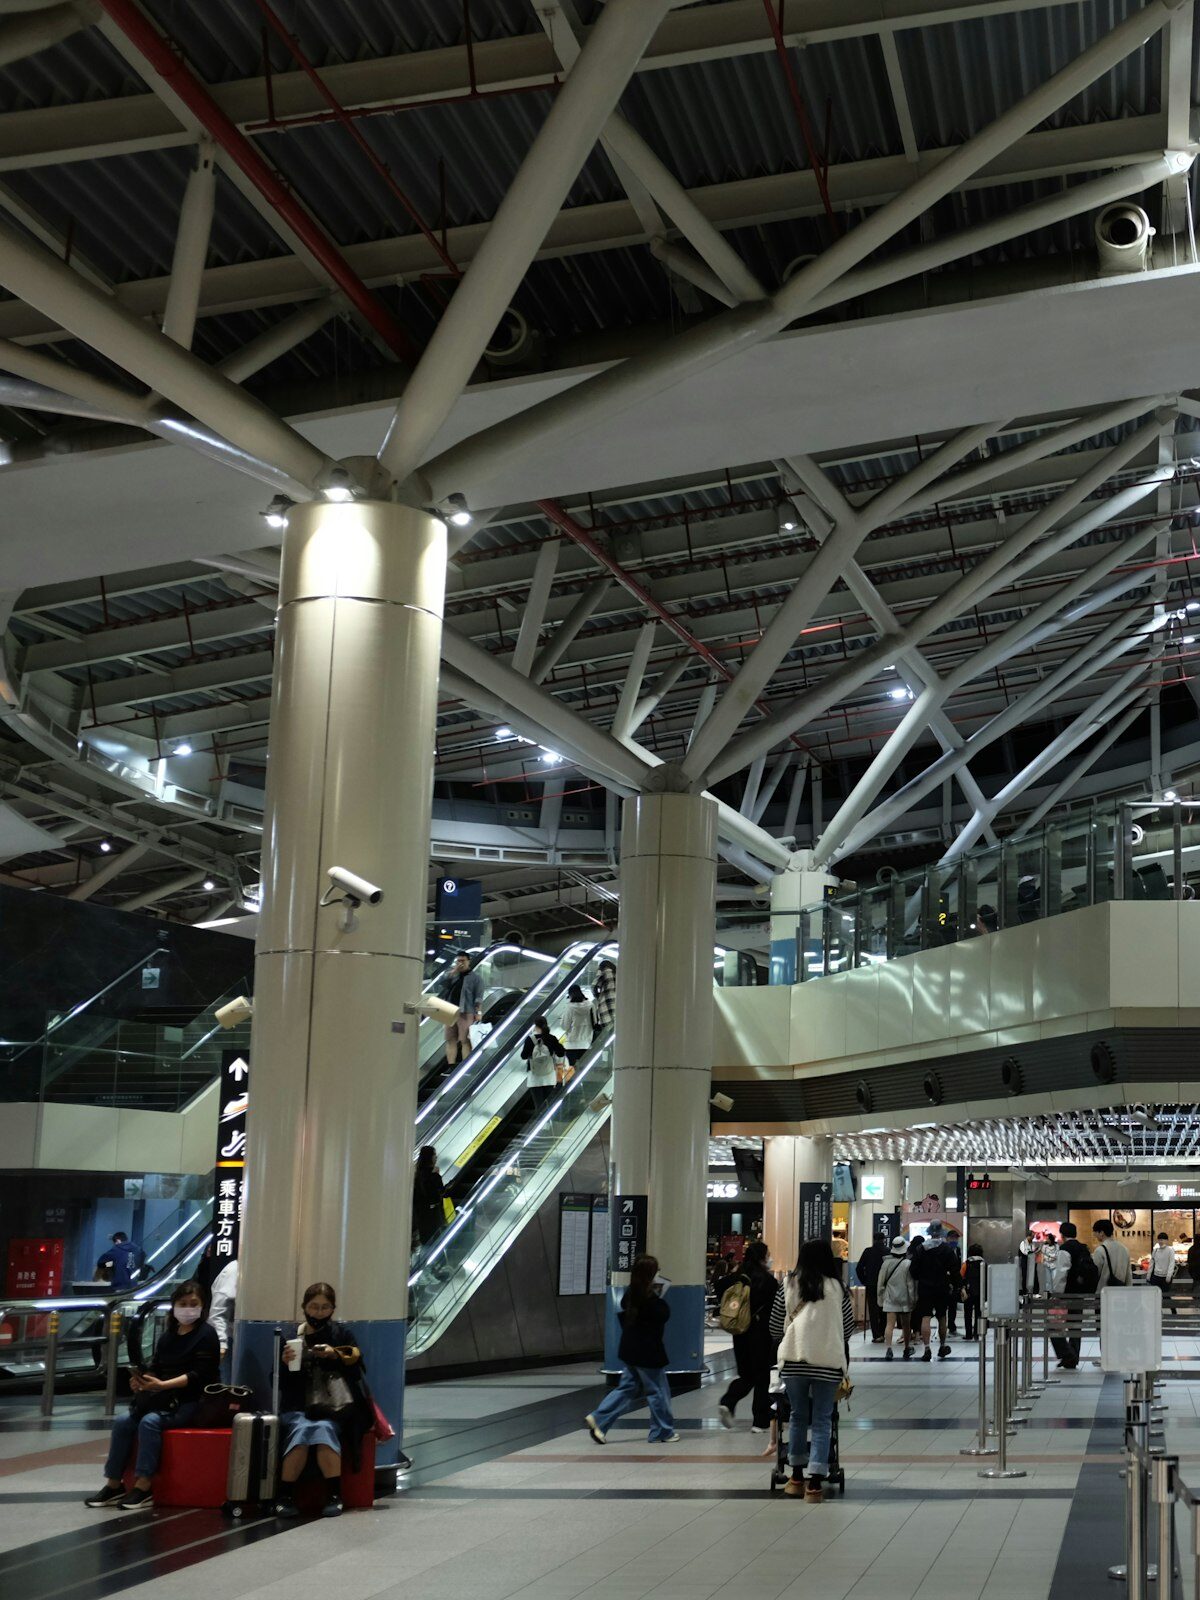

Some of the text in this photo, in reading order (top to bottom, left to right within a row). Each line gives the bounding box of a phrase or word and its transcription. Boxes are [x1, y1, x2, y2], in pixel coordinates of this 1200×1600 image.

[969, 1181, 991, 1190] 19:11
[216, 1179, 237, 1257] 乘車方向
[619, 1241, 629, 1269] 電梯
